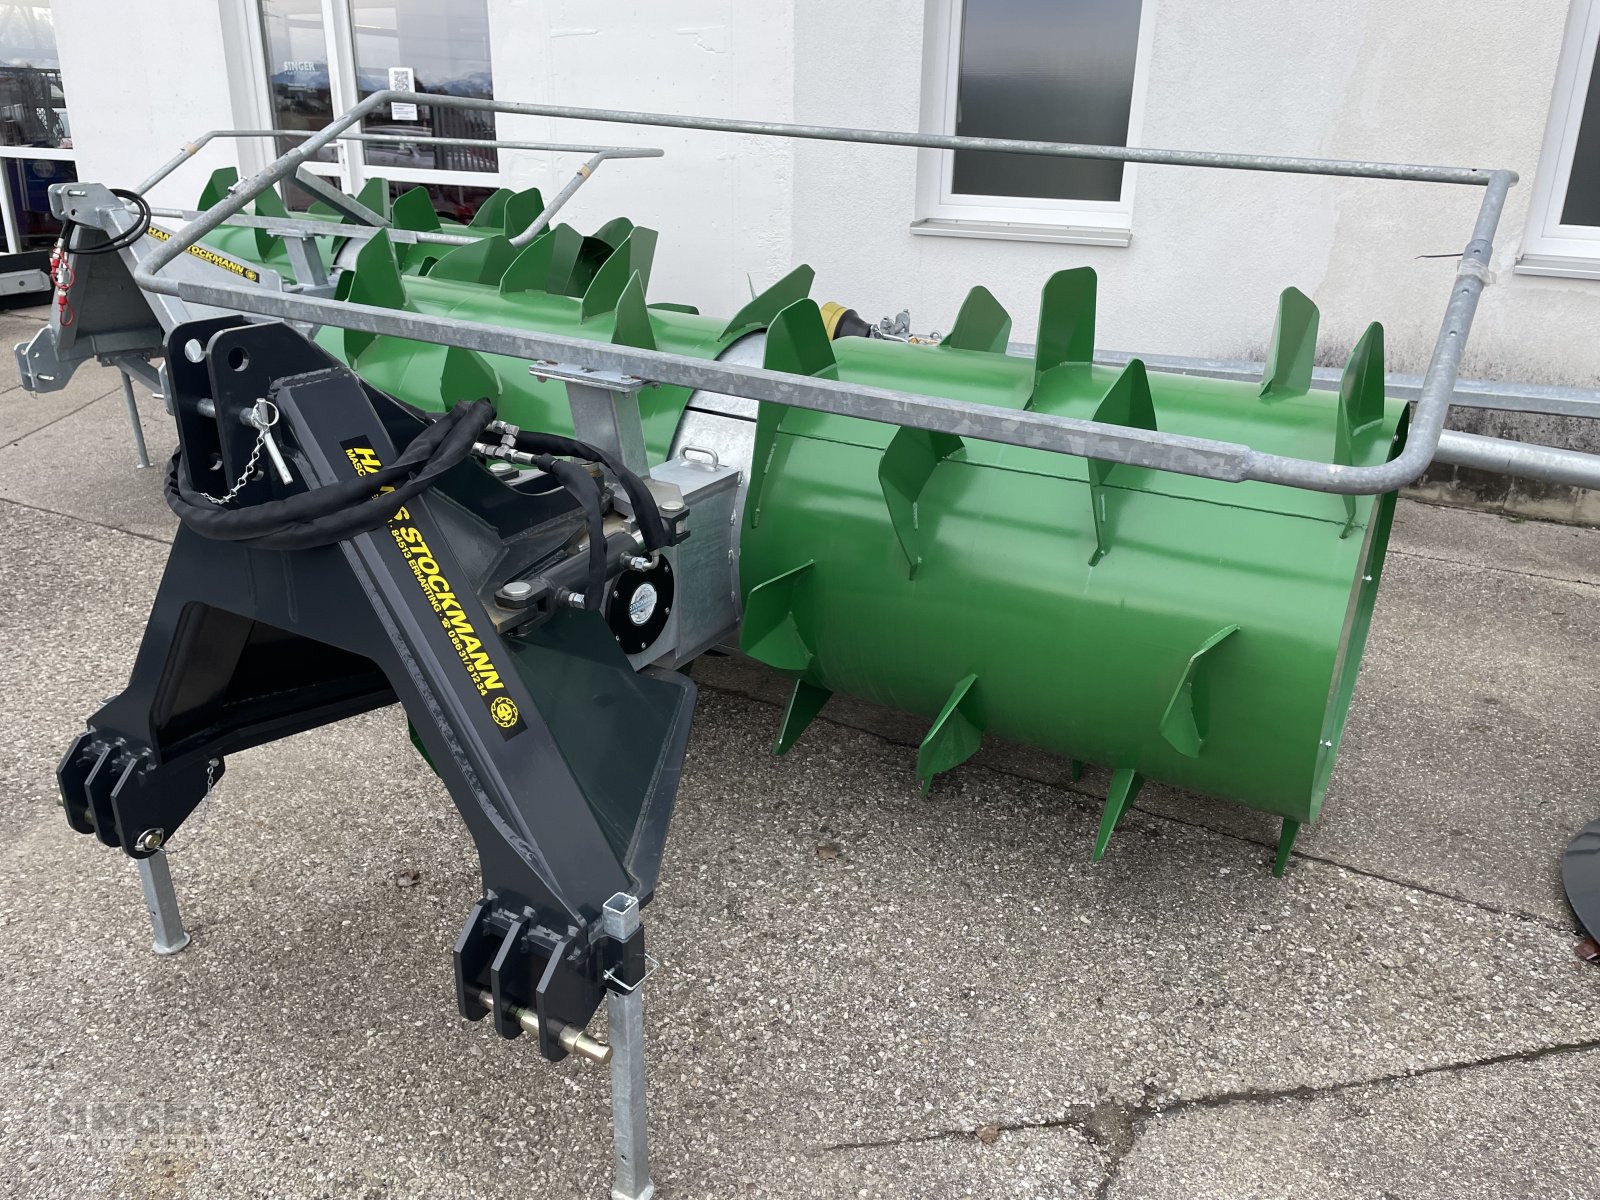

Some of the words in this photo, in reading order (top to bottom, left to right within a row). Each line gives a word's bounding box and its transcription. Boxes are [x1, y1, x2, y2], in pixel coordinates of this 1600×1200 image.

[283, 61, 316, 71] SINGER
[391, 529, 413, 560] 84513
[408, 559, 442, 613] ERHARTING
[447, 630, 488, 696] 08631/91234
[399, 526, 505, 690] STOCKMANN
